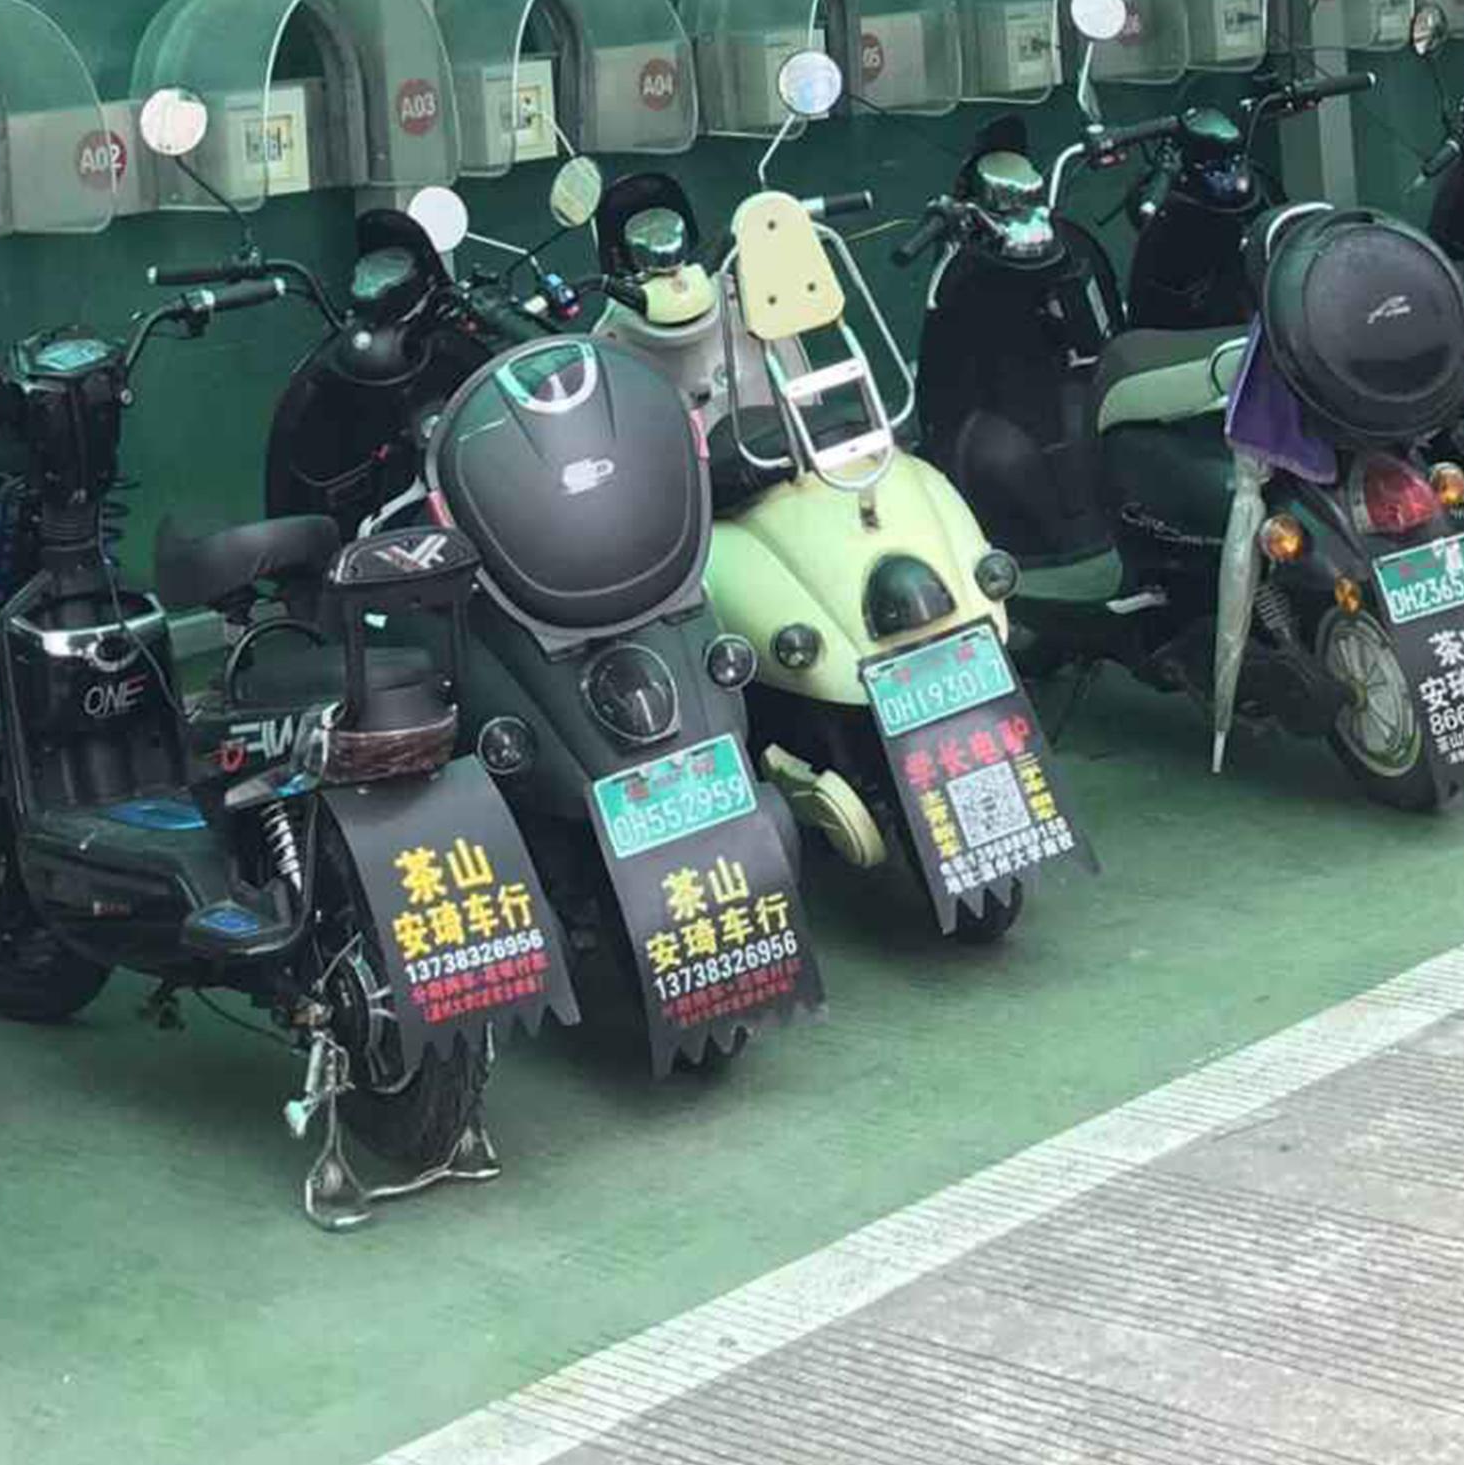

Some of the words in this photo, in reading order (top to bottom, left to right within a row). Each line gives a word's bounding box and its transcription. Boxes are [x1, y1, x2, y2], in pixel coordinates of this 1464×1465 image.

[401, 92, 436, 122] A03
[642, 74, 674, 97] A04
[79, 144, 123, 172] A02
[393, 837, 495, 904] 茶山
[661, 856, 751, 922] 茶山
[392, 882, 532, 961] 安琦车行
[645, 892, 789, 976] 安琦车行
[404, 927, 545, 985] 13738326956
[654, 928, 799, 1002] 13738326956
